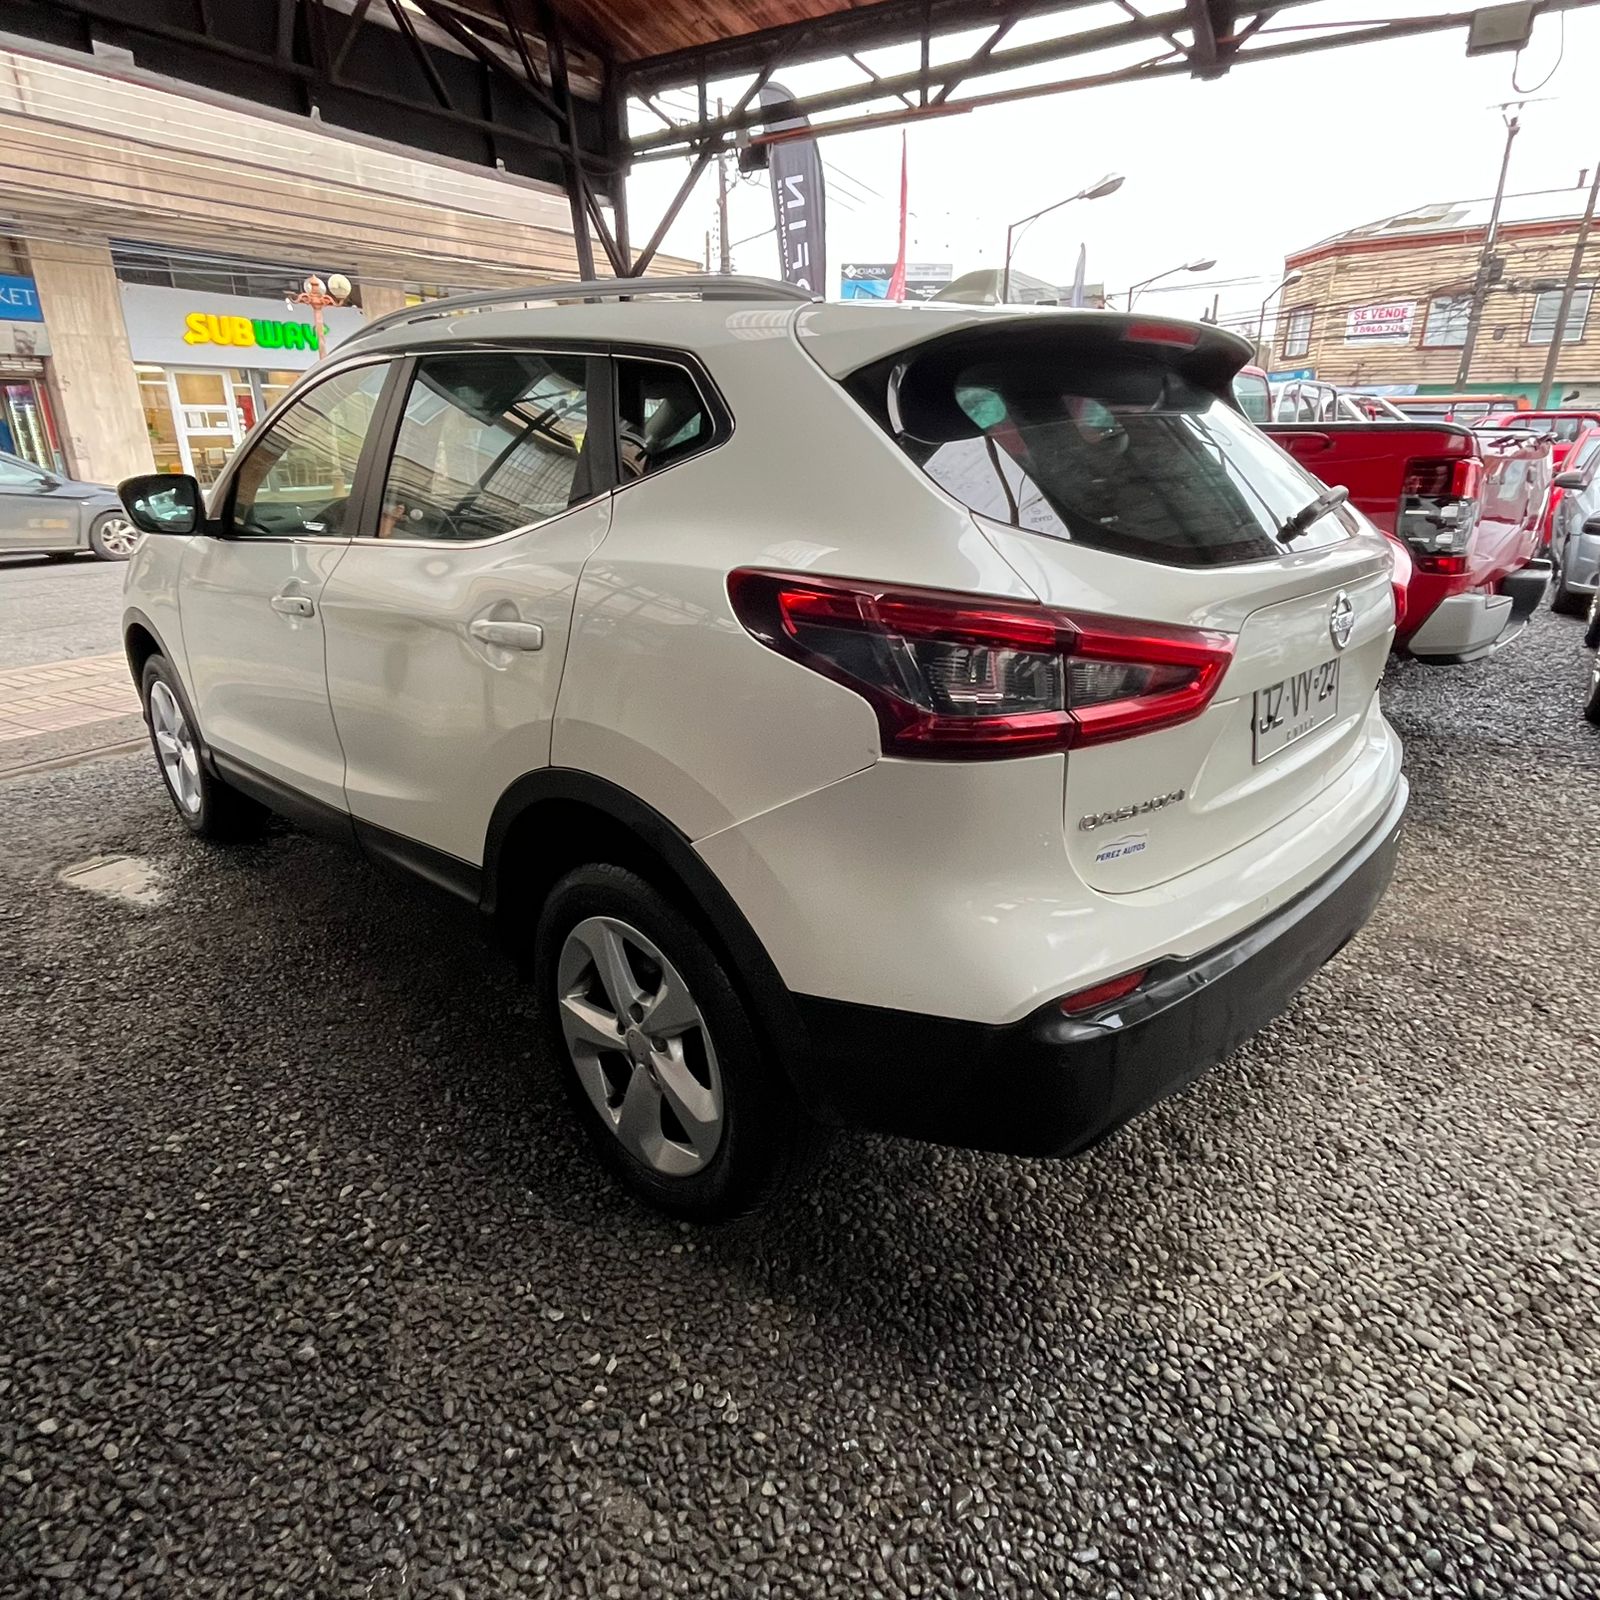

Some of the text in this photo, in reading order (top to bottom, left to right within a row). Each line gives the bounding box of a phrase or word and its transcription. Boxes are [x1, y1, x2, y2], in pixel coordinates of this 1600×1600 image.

[1354, 307, 1408, 320] SE VENDE
[183, 312, 329, 351] SUBWAY
[1078, 789, 1186, 832] QASHQAI
[1095, 842, 1146, 862] PEREZ AUTOS
